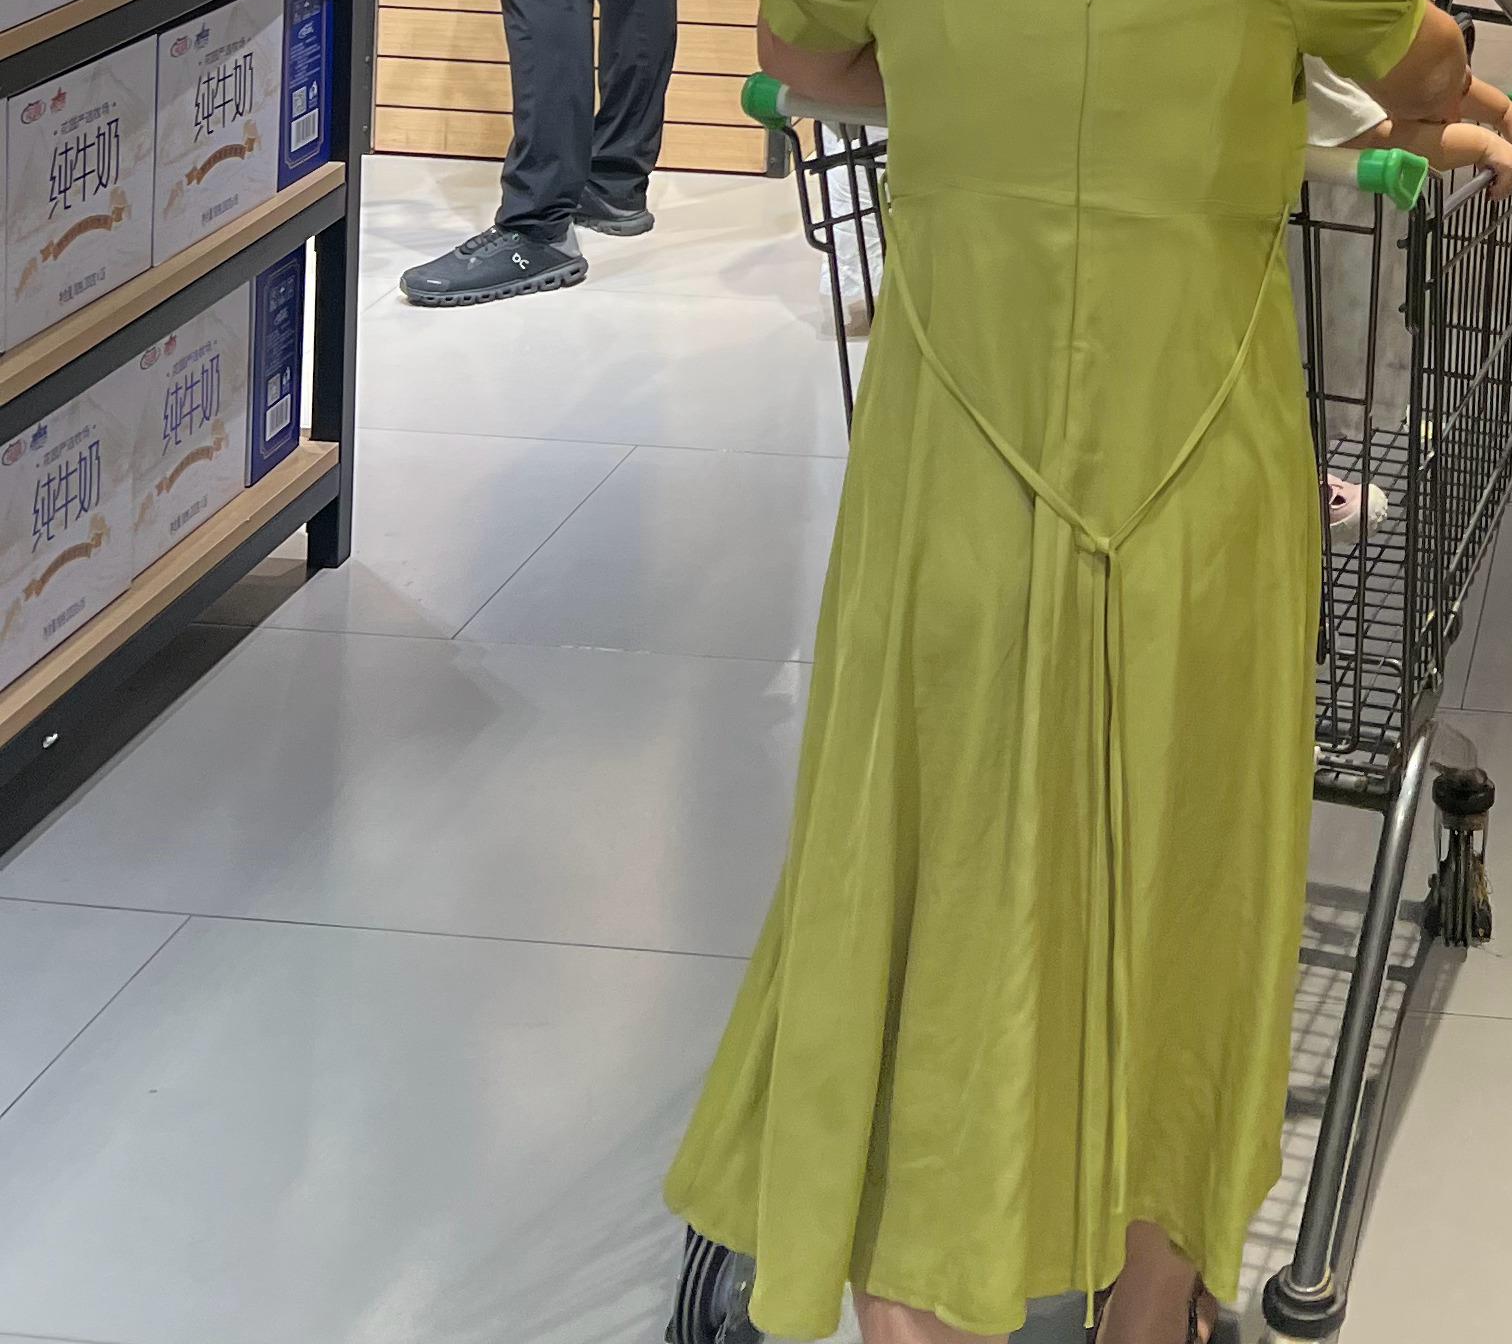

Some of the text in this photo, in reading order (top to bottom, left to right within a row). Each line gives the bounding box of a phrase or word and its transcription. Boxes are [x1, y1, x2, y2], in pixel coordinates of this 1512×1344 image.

[193, 51, 254, 144] 纯牛奶
[48, 117, 120, 220] 纯牛奶
[161, 353, 221, 457] 纯牛奶
[31, 439, 102, 555] 纯牛奶
